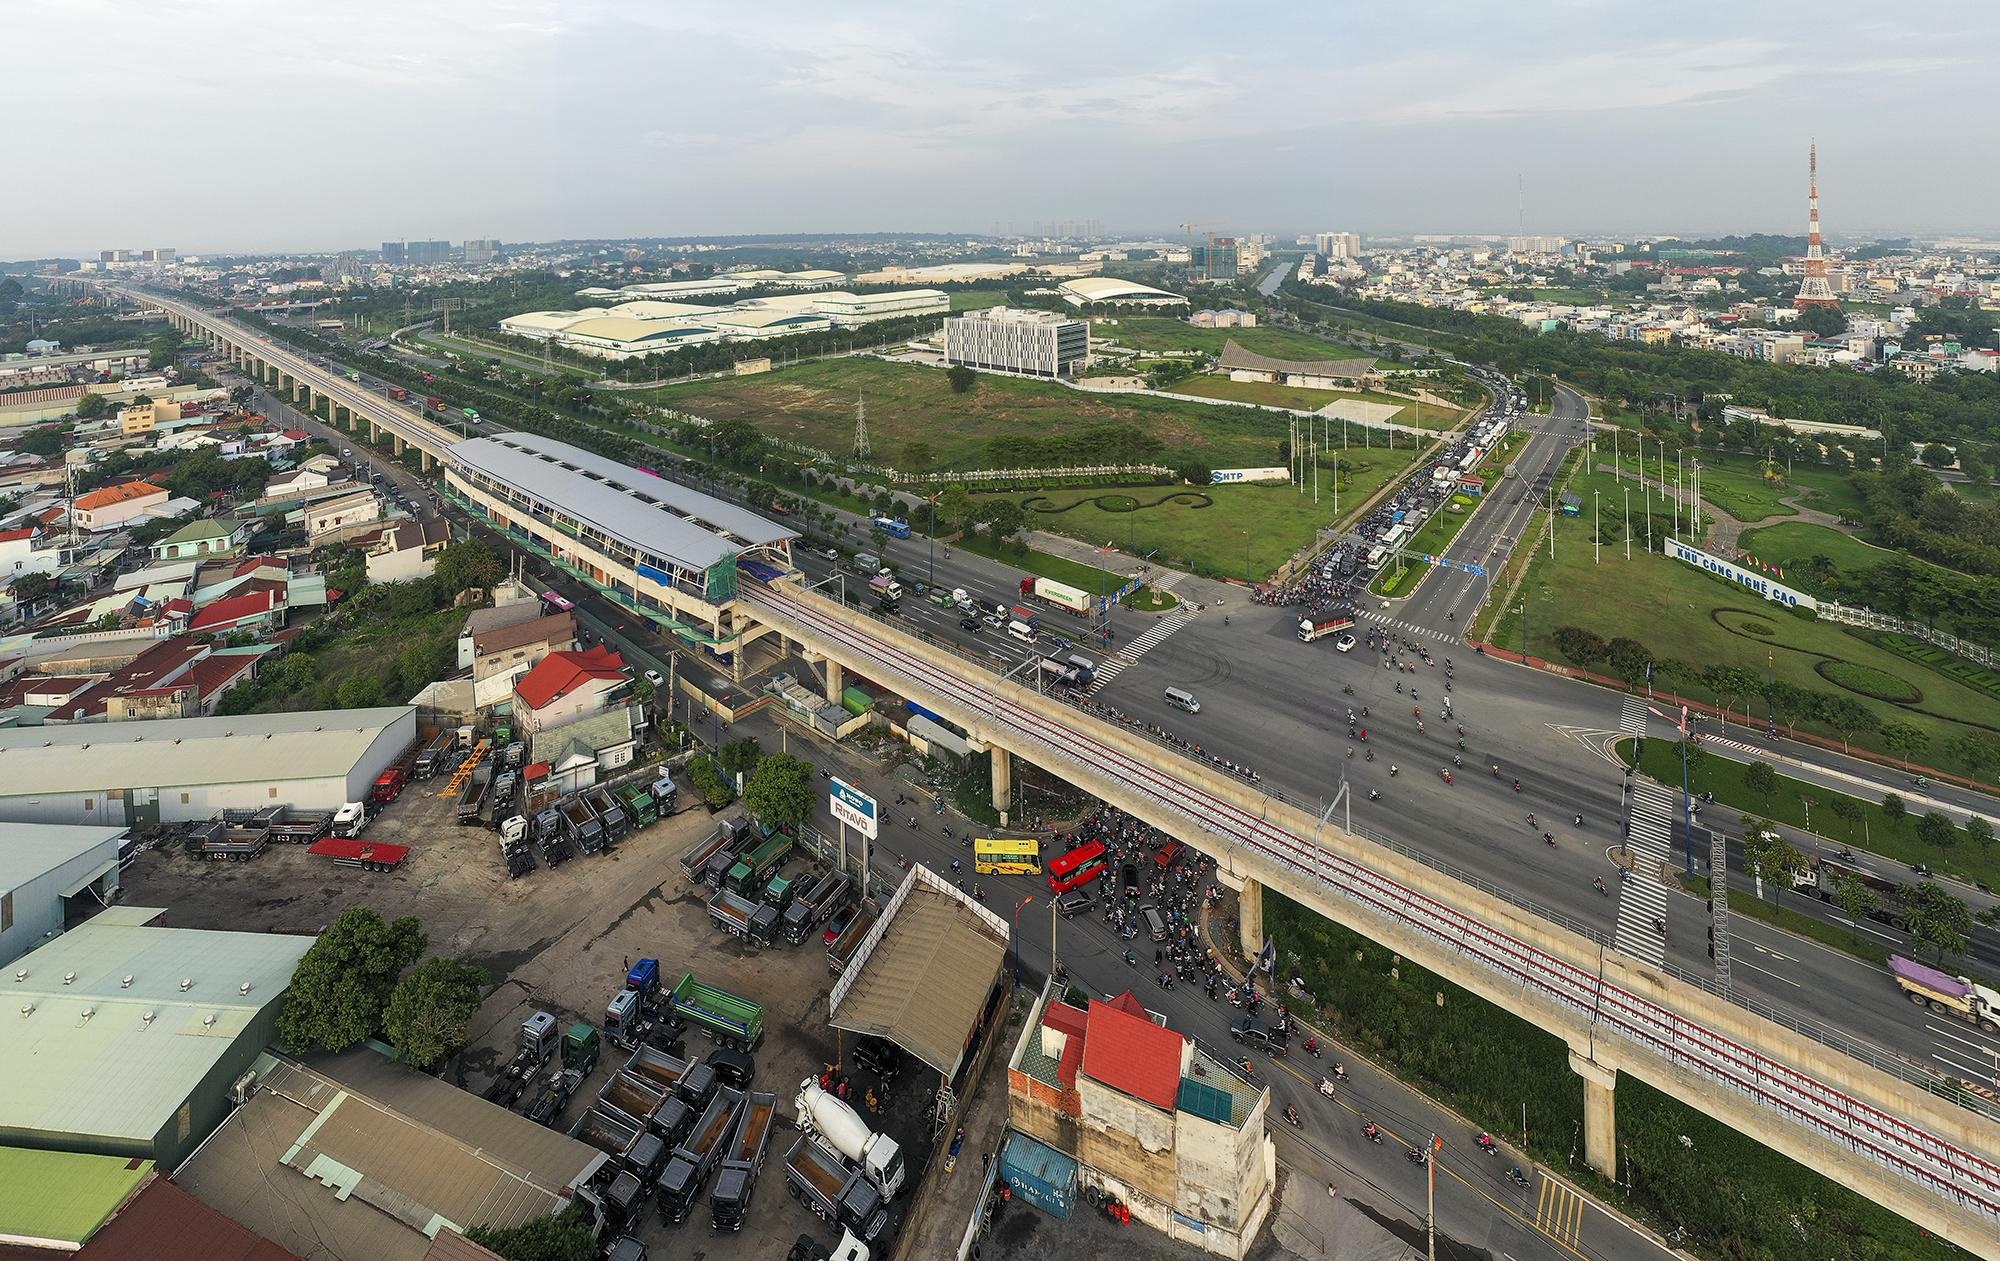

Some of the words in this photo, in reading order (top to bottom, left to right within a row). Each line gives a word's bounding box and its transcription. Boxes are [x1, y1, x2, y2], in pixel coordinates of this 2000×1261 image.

[1677, 547, 1698, 564] KHU
[1703, 559, 1732, 579] CÔNG
[1772, 588, 1797, 607] CAO
